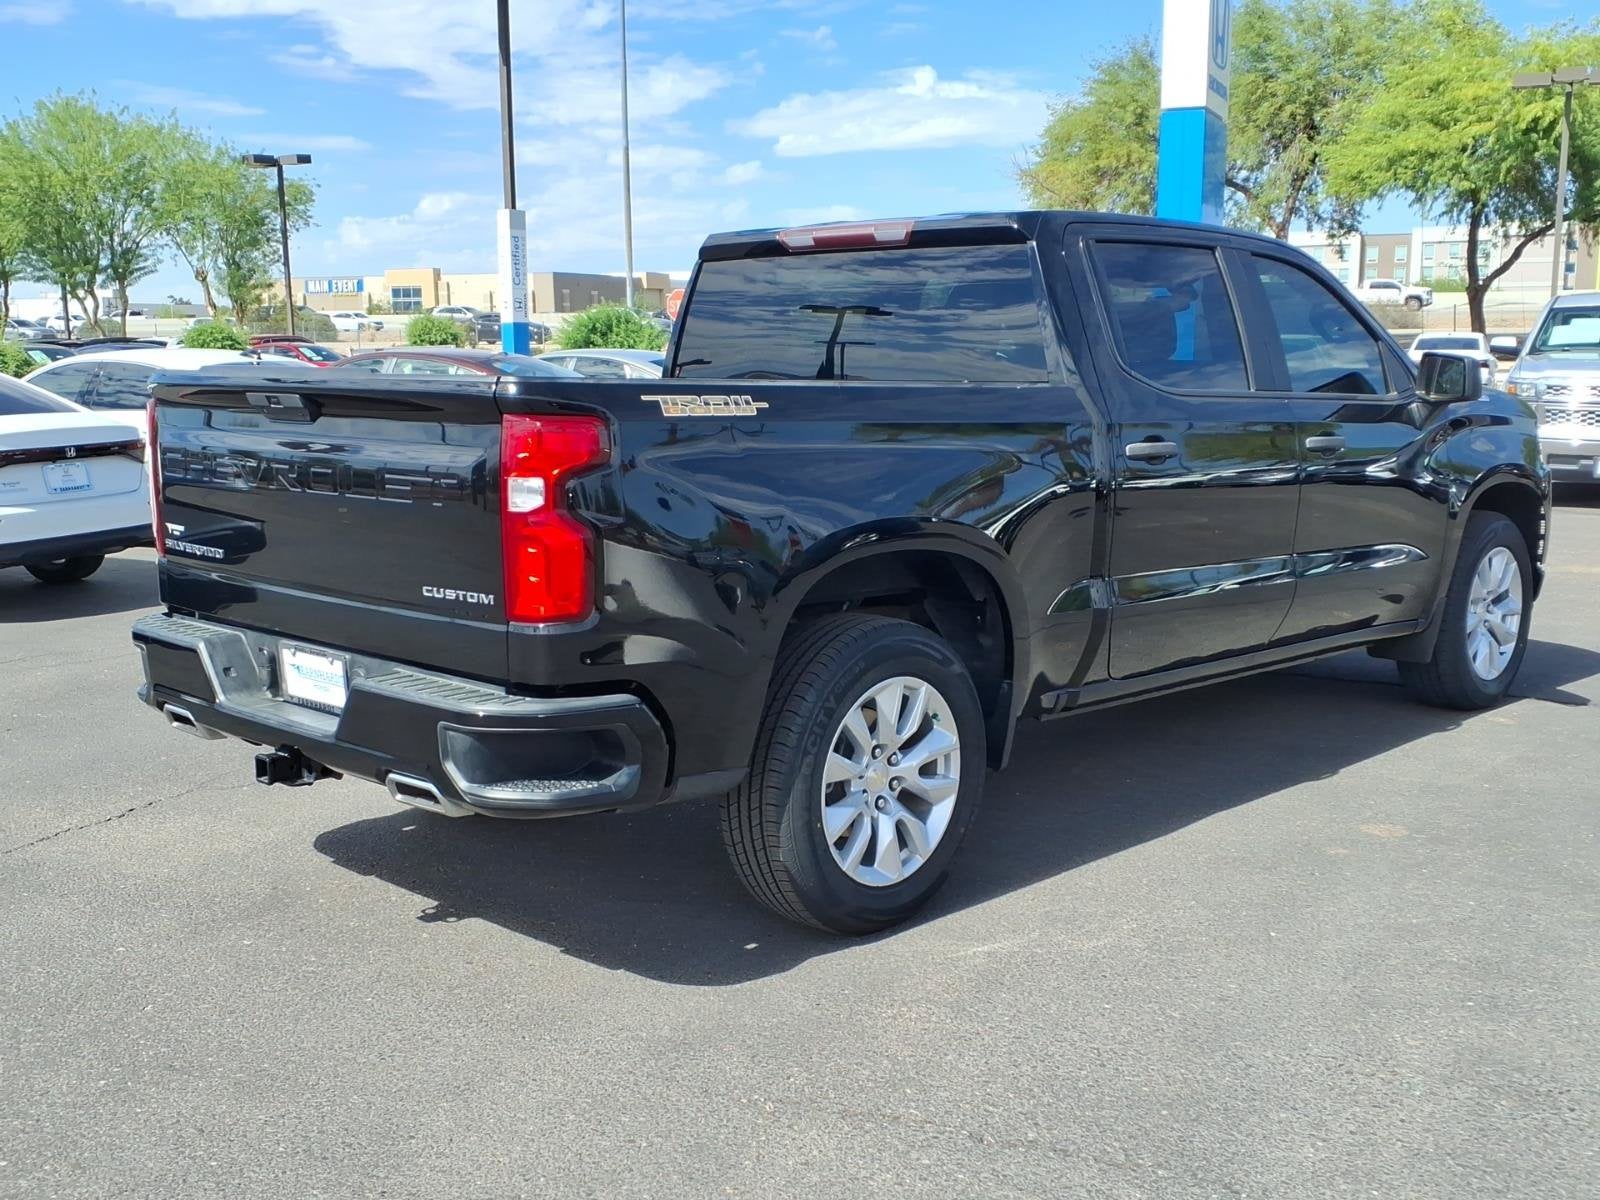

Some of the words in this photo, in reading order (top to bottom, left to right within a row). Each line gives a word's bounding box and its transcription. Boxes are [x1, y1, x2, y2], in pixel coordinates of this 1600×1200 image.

[512, 236, 521, 286] Certified
[331, 280, 359, 292] EVENT
[422, 585, 495, 605] CUSTOM
